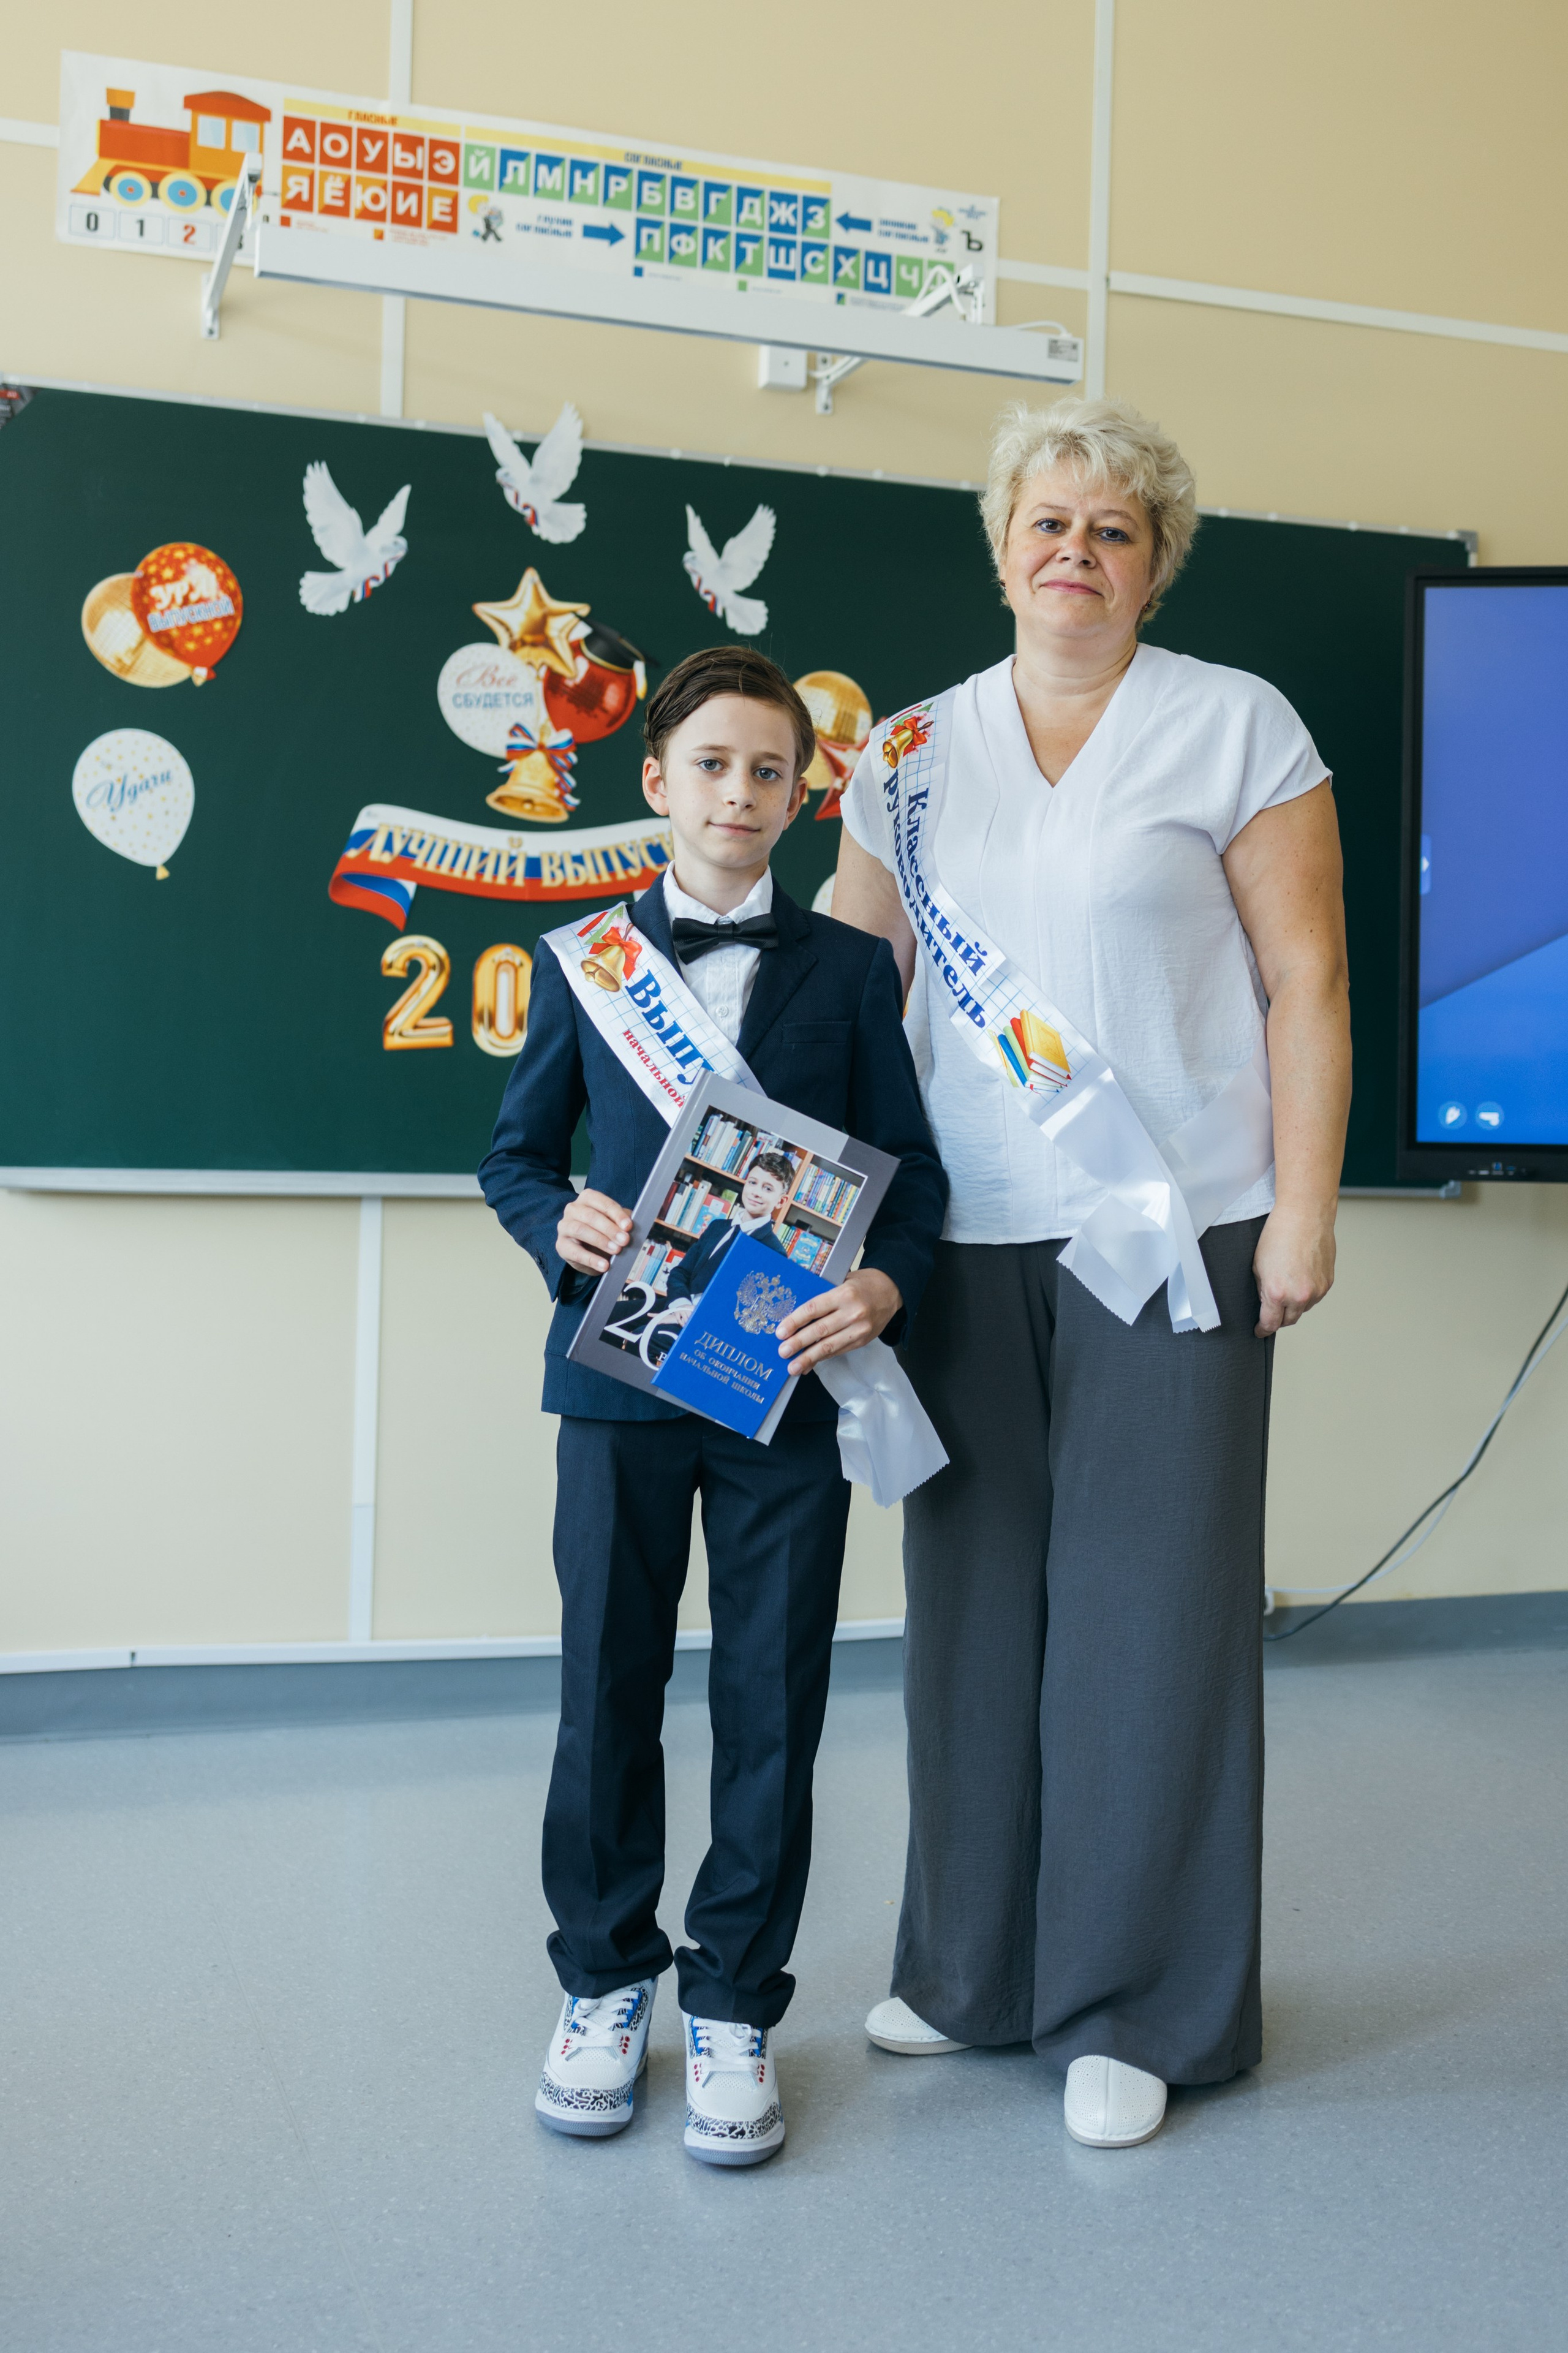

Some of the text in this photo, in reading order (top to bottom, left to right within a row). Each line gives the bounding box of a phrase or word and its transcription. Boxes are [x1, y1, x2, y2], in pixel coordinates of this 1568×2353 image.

[286, 127, 456, 175] А О У Ы Э
[286, 175, 453, 223] Я Ё Ю И Е
[469, 148, 826, 229] Й Л М Н Р Б В Г Д Ж З
[86, 212, 196, 244] 0 1 2
[640, 226, 660, 252] П
[670, 232, 696, 256] Ф
[707, 236, 727, 262] К
[739, 241, 760, 266] Т
[769, 245, 796, 271] Ш
[804, 250, 825, 274] С
[837, 254, 856, 280] Х
[867, 259, 889, 289] Ц
[900, 264, 919, 289] Ч
[147, 594, 235, 633] ВЫПУСКНОЙ
[456, 662, 518, 687] Все
[452, 692, 534, 709] СБУДЕТСЯ
[86, 770, 171, 812] Удачи
[346, 823, 527, 887] ЛУЧШИЙ
[883, 769, 986, 1029] руководитель
[906, 787, 987, 976] Классный
[381, 934, 533, 1057] 20
[622, 1029, 685, 1108] начальной
[679, 1352, 764, 1404] НАЧАЛЬНОЙ ШКОЛЫ
[694, 1331, 774, 1381] ДИПЛОМ
[694, 1350, 760, 1390] ОБ ОКОНЧАНИИ
